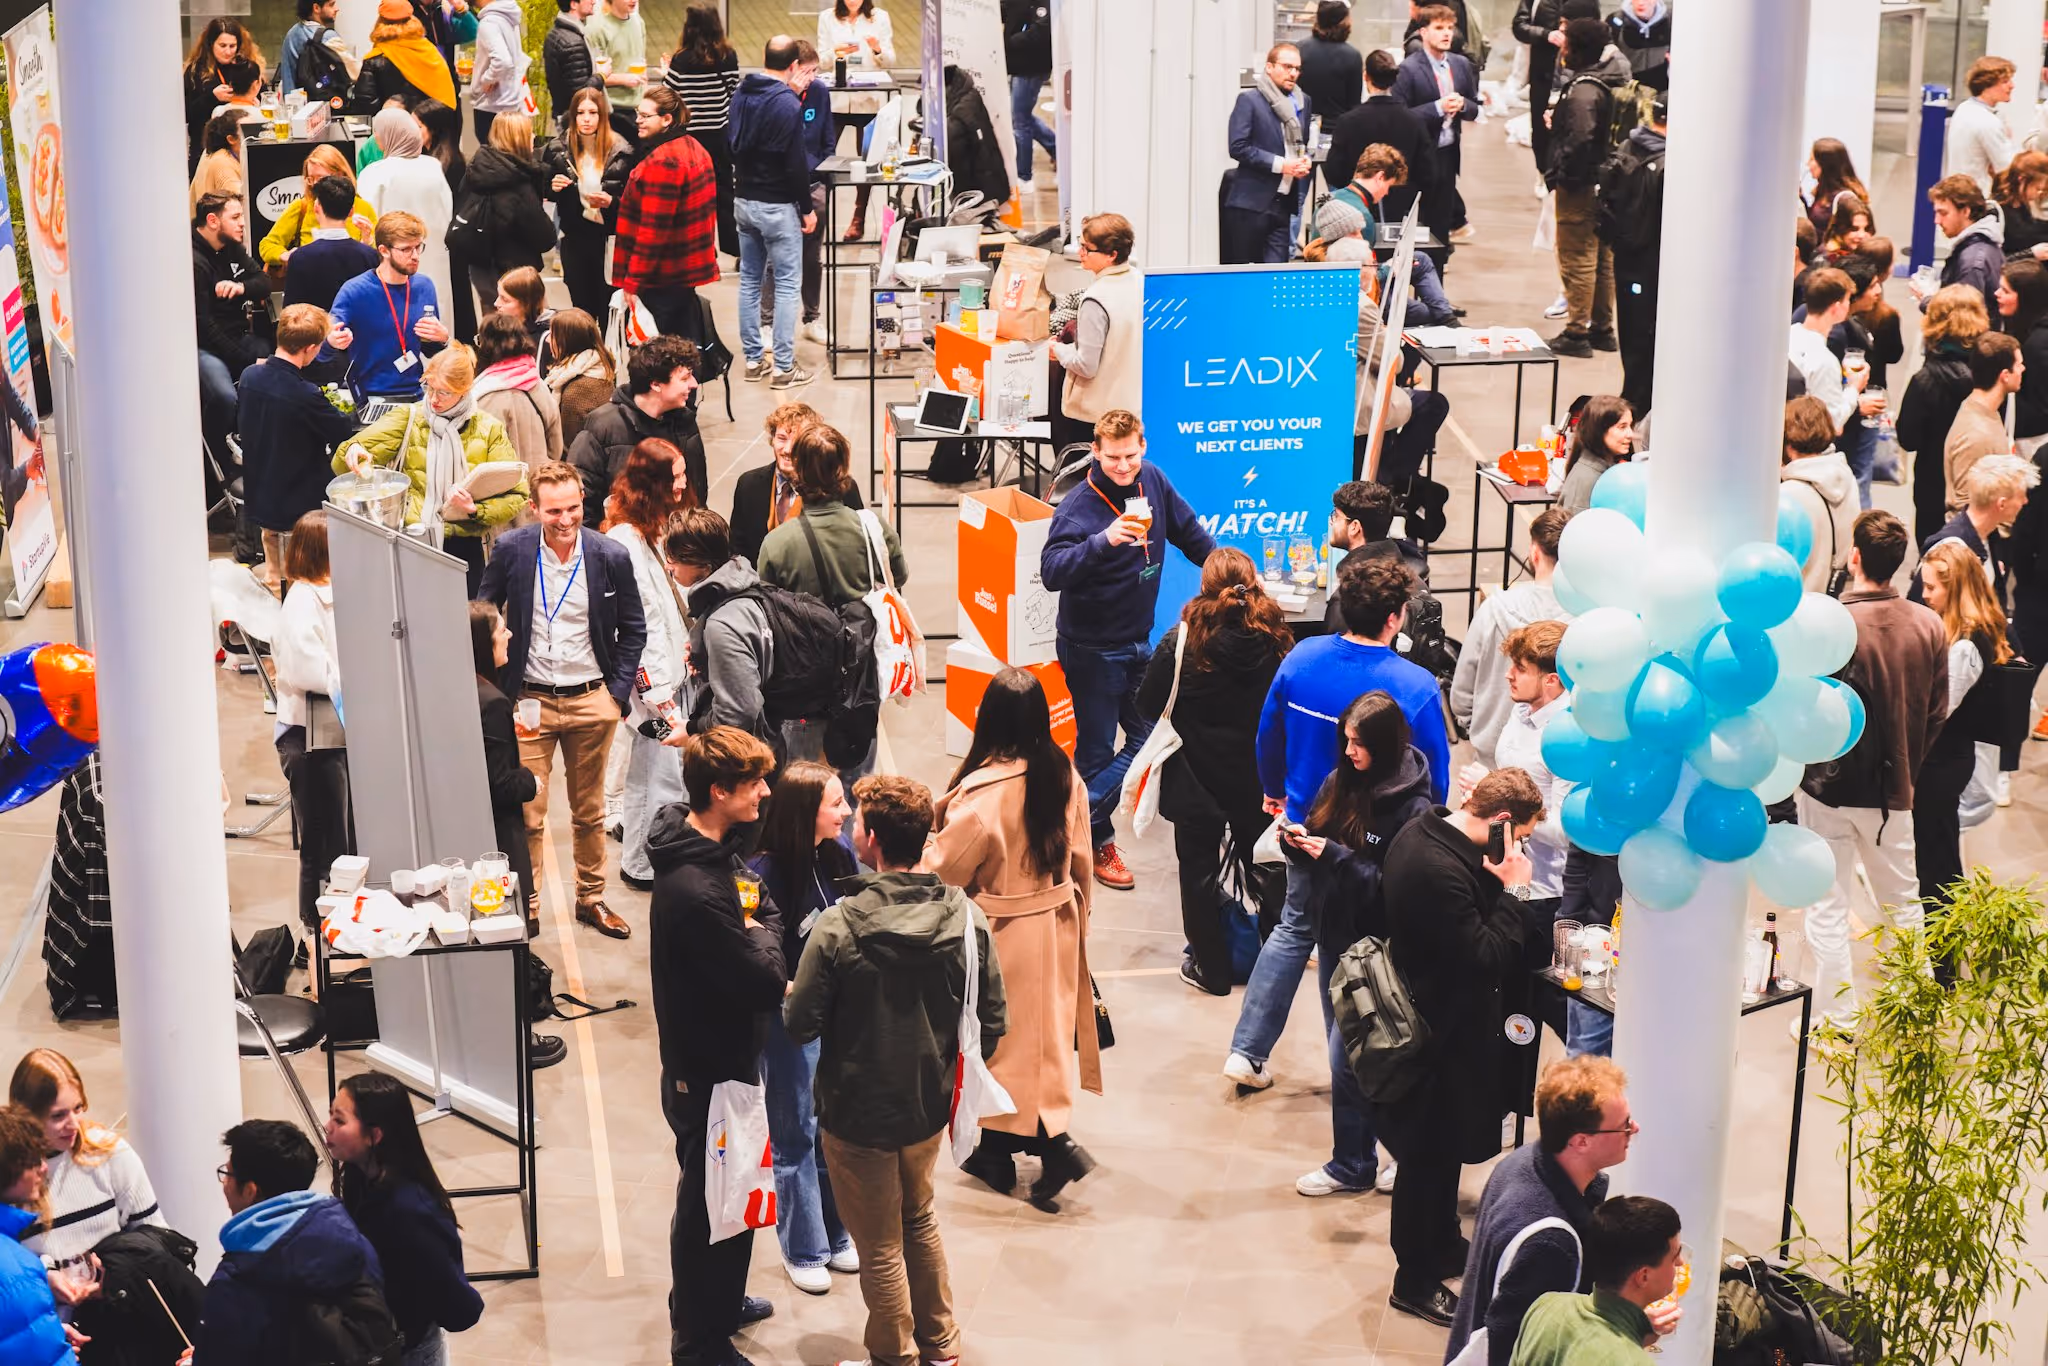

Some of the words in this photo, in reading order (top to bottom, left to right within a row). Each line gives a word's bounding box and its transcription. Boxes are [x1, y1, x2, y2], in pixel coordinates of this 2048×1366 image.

[267, 186, 305, 206] Smo
[1184, 348, 1323, 388] LEADIX
[1177, 421, 1204, 434] WE
[1207, 420, 1238, 433] GET
[1241, 418, 1274, 431] YOU
[1277, 417, 1321, 430] YOUR
[1196, 439, 1237, 453] NEXT
[1240, 437, 1304, 452] CLIENTS
[1234, 499, 1255, 509] IT'S
[1258, 498, 1267, 508] A
[1199, 510, 1308, 536] MATCH!
